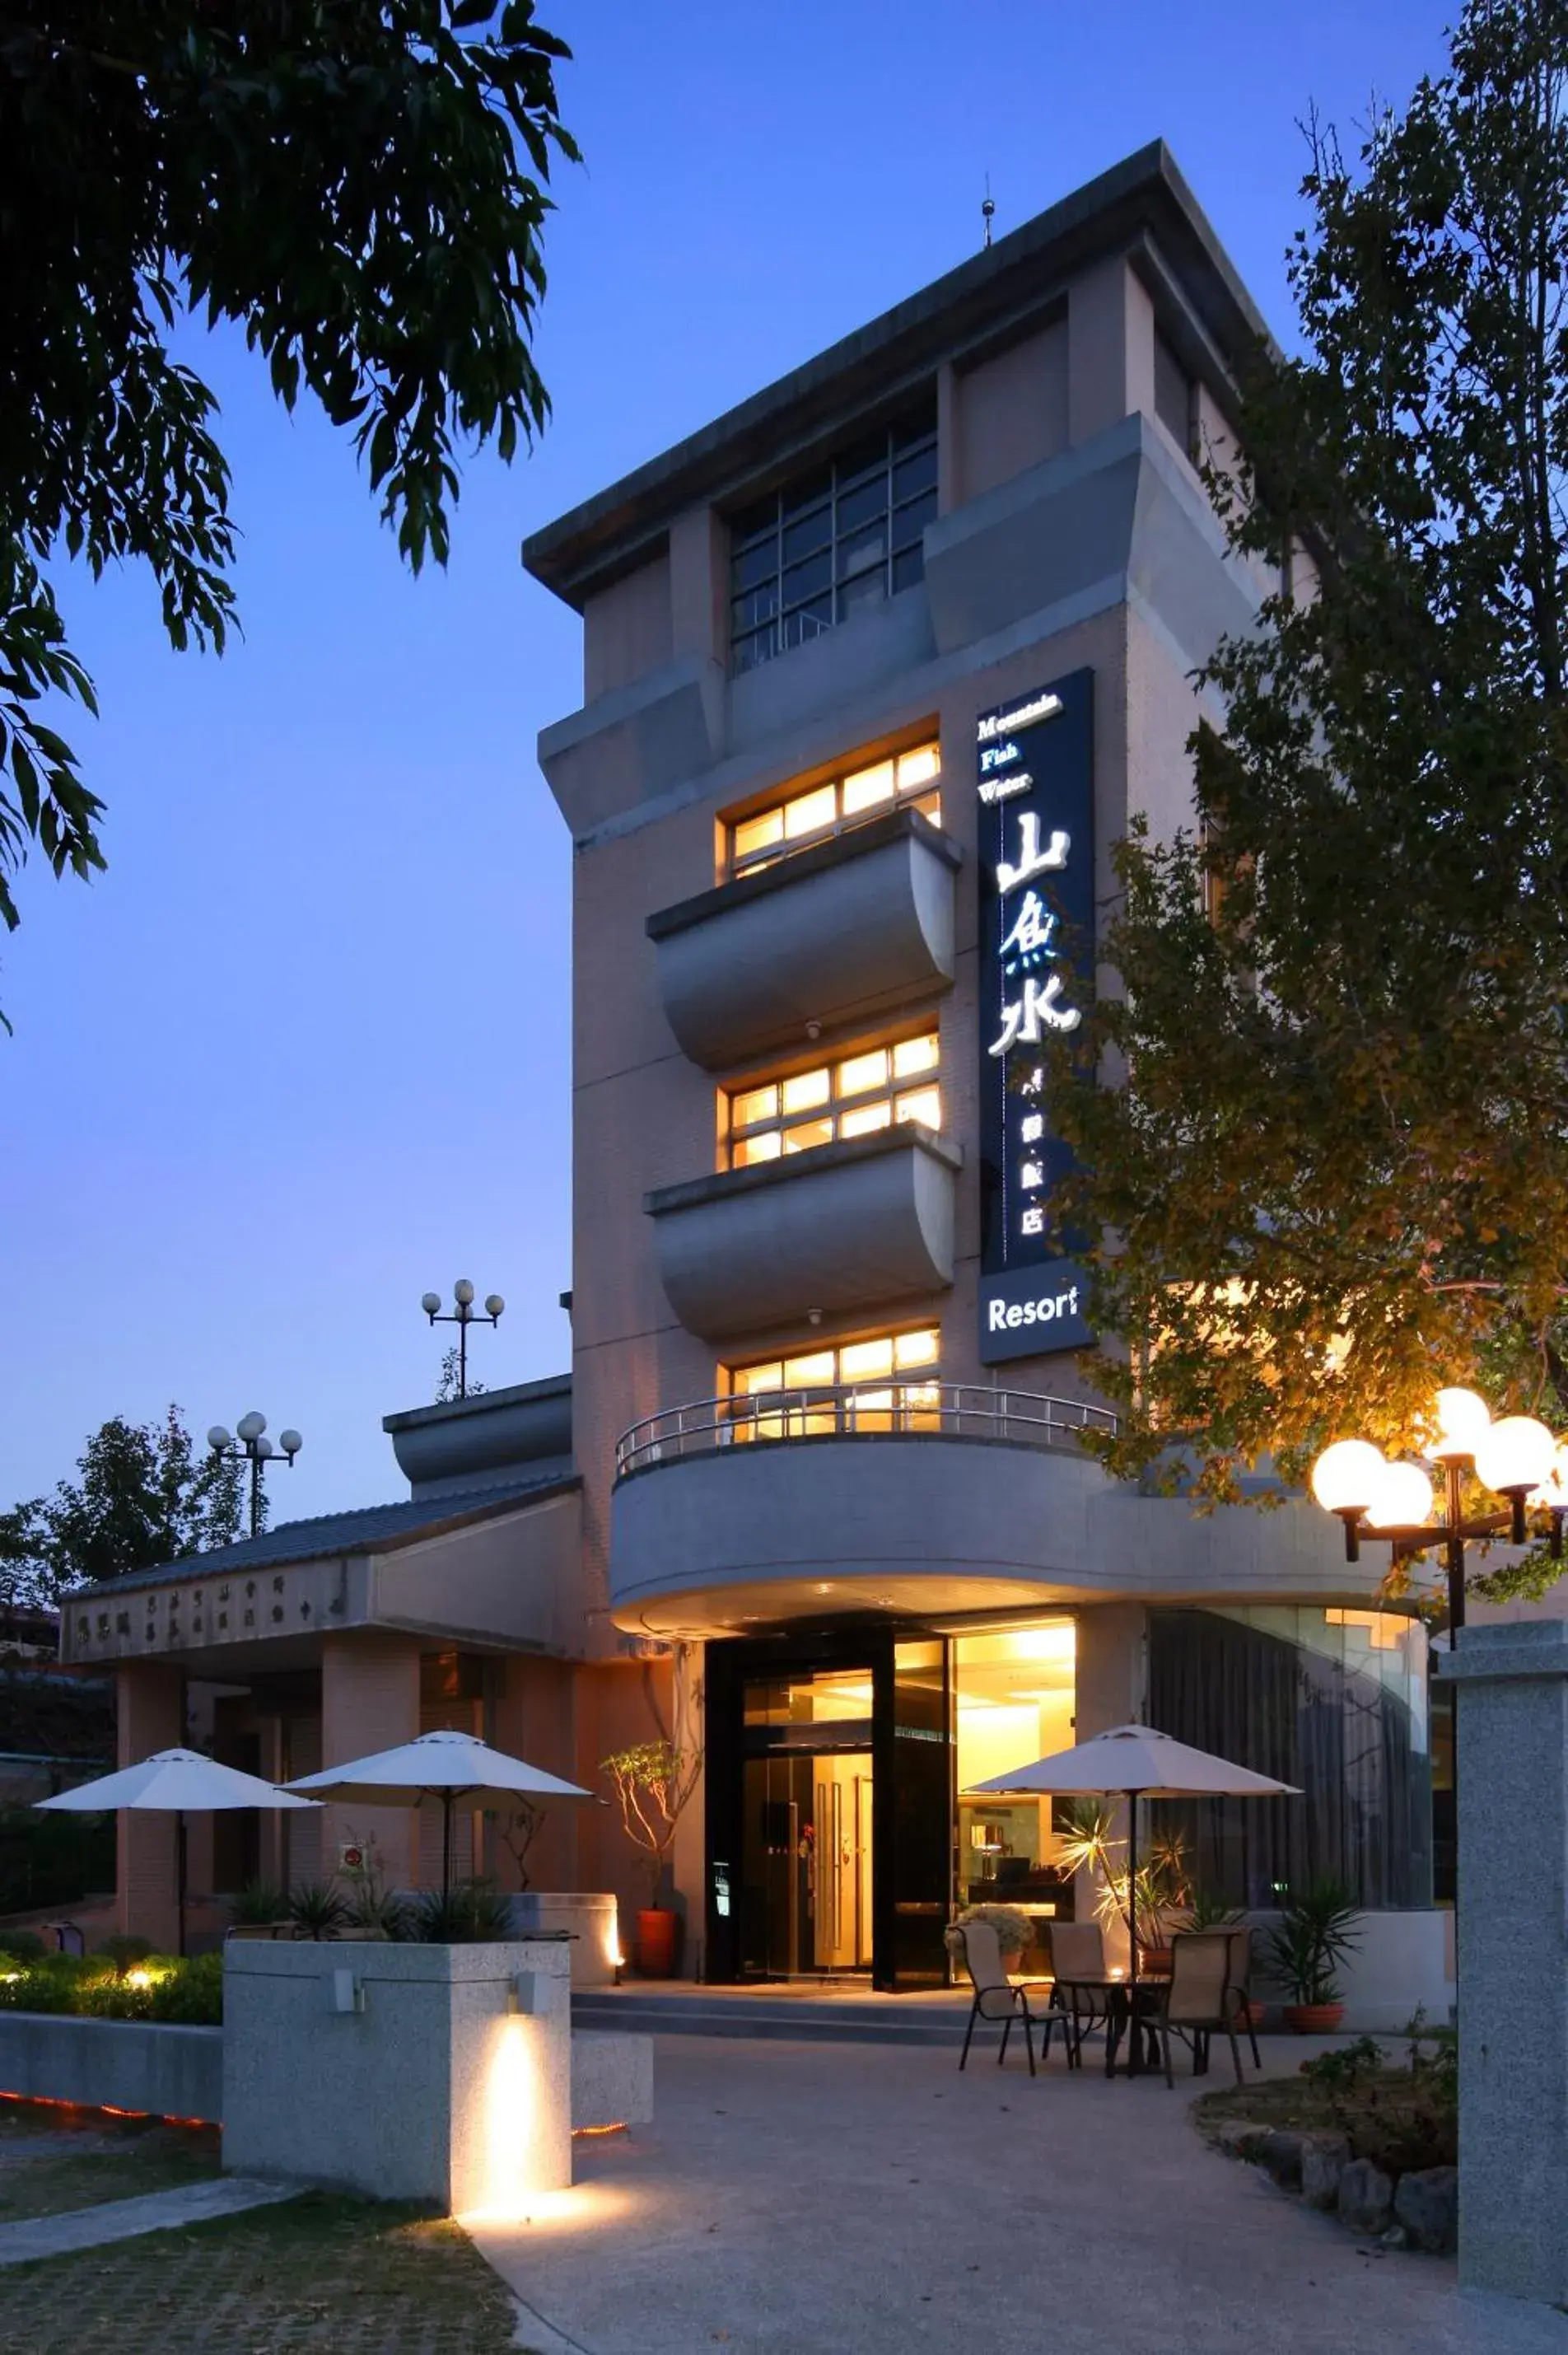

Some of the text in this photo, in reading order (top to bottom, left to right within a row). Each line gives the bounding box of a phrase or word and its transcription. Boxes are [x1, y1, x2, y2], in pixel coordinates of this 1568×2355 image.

[980, 743, 1020, 772] Fish
[977, 773, 1032, 803] Water
[988, 811, 1082, 1057] 山魚水
[988, 1286, 1079, 1332] Resort
